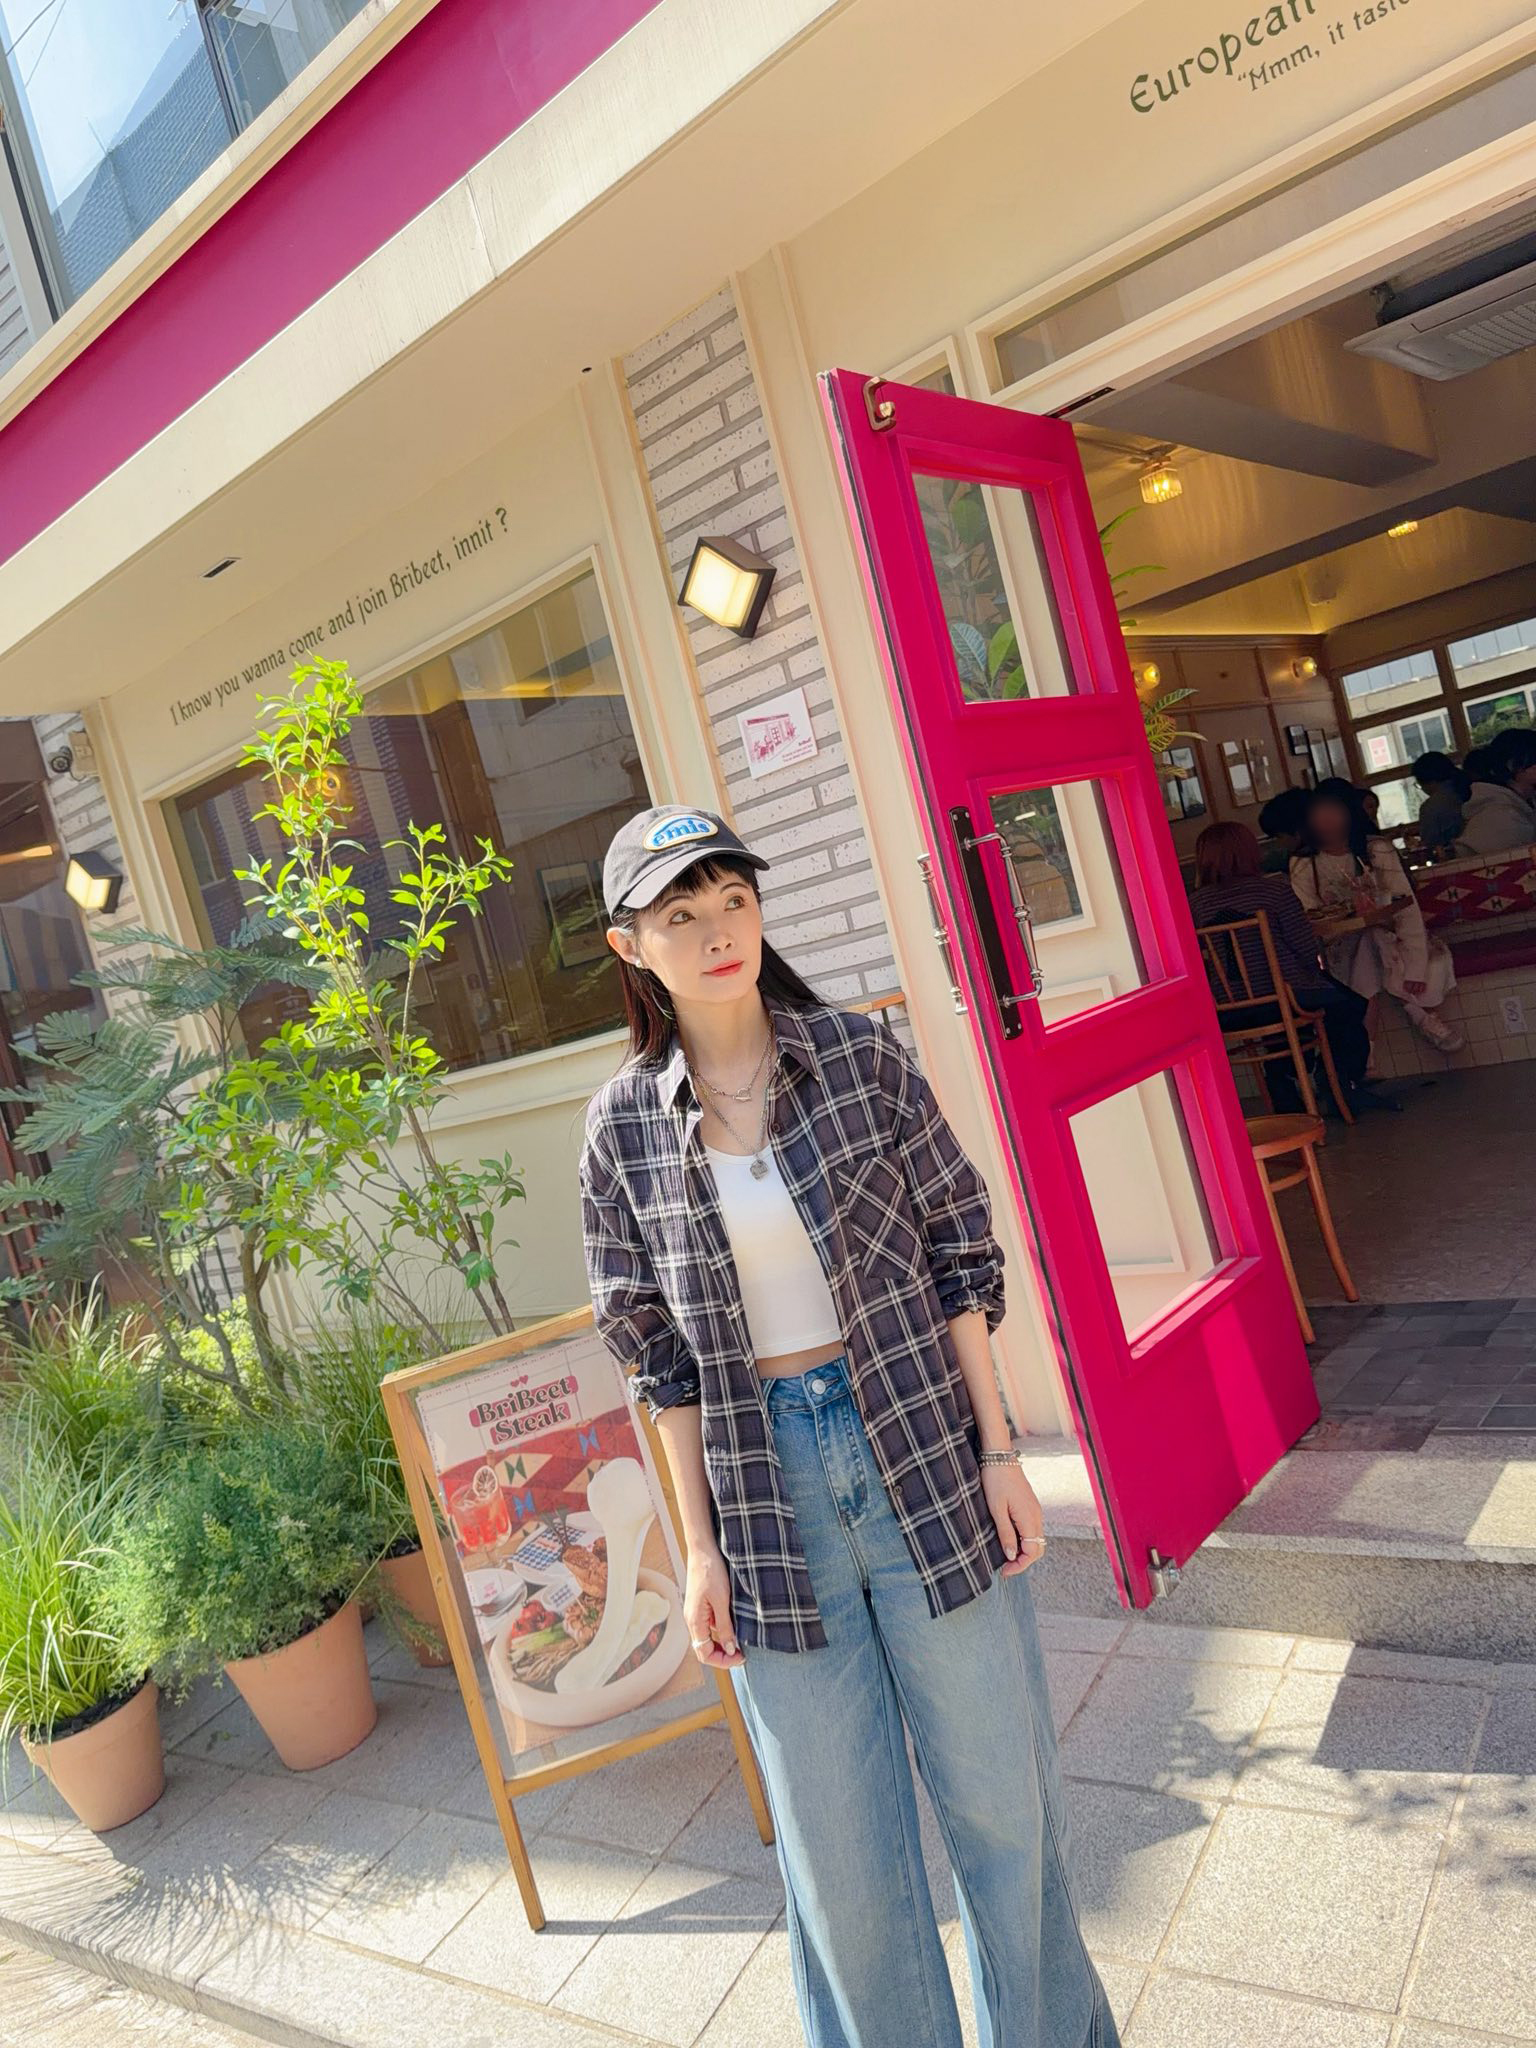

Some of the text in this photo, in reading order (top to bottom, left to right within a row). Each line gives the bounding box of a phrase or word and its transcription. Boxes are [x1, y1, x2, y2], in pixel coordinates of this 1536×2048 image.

[1327, 22, 1345, 45] it
[1129, 0, 1316, 113] European
[169, 704, 179, 726] I
[177, 691, 212, 721] know
[214, 675, 241, 707] you
[241, 649, 286, 684] wanna
[288, 626, 325, 657] come
[328, 600, 355, 635] and
[356, 588, 389, 625] join
[389, 549, 451, 600] Bribeet,
[453, 519, 494, 560] innit
[653, 819, 710, 846] emis
[477, 1378, 571, 1423] BriBeet
[495, 1402, 568, 1441] Steak
